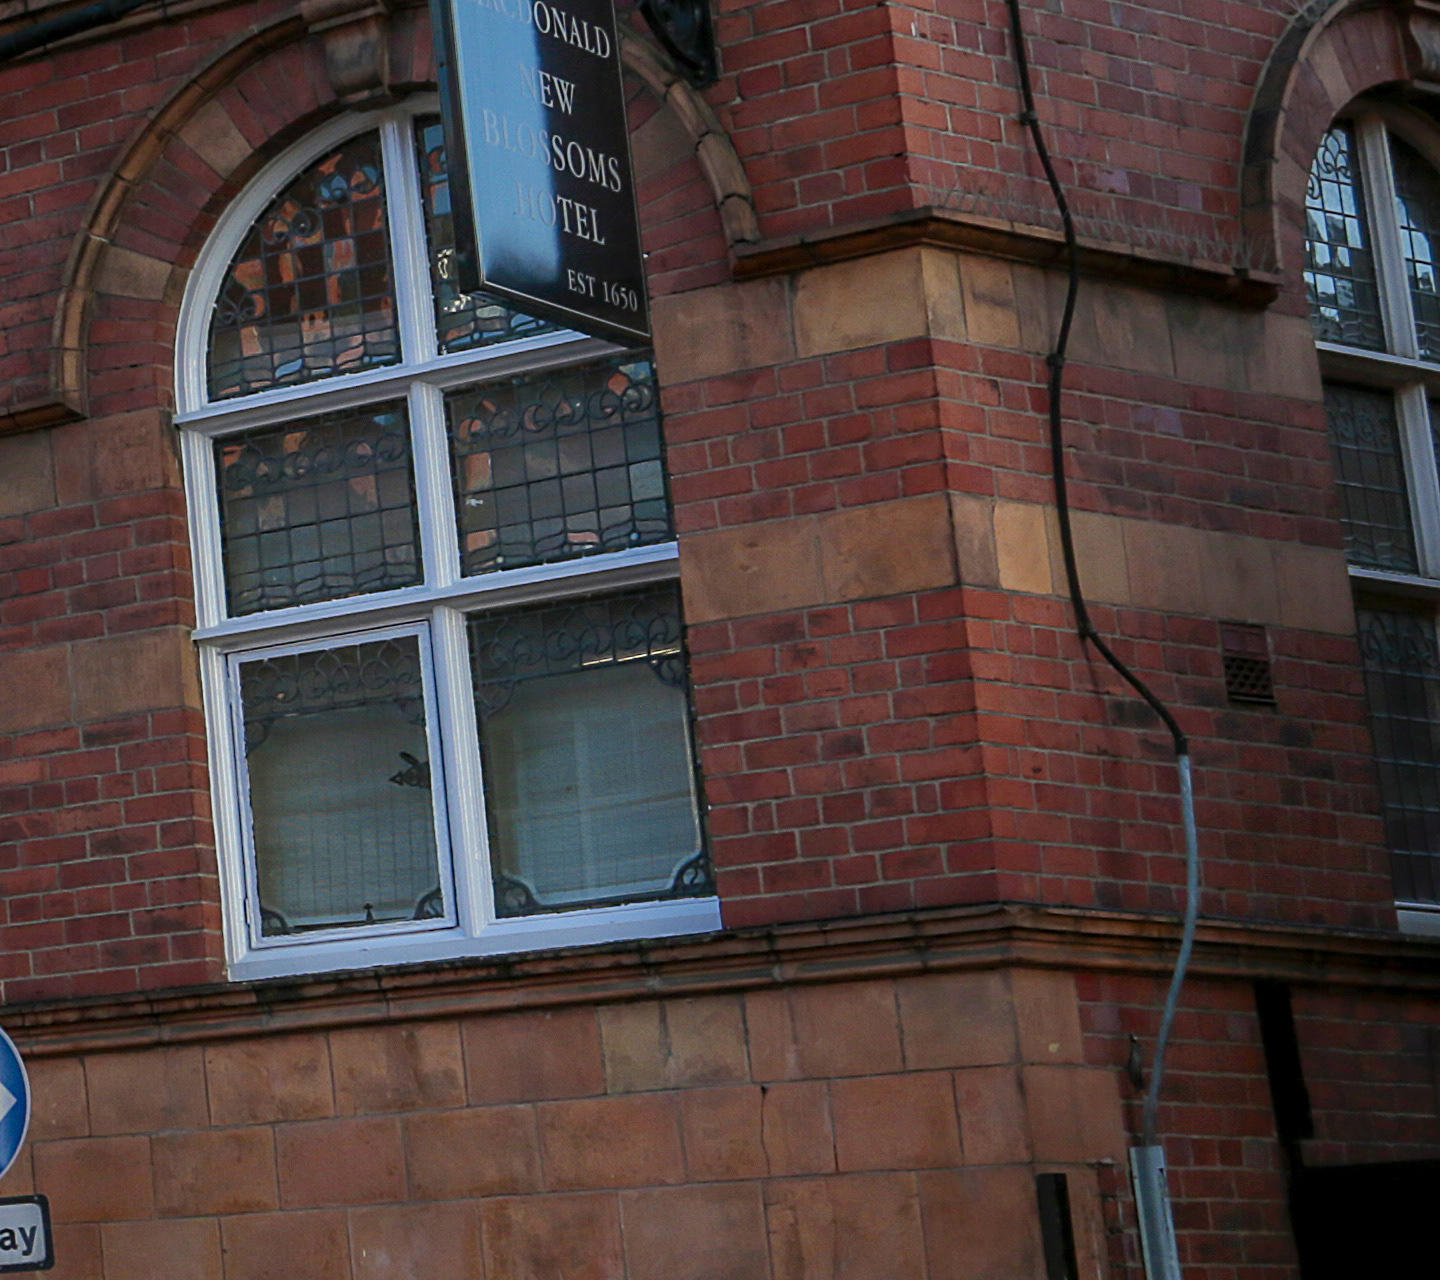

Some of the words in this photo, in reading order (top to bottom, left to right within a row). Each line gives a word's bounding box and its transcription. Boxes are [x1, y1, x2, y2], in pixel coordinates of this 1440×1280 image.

[519, 63, 575, 115] NEW
[481, 108, 621, 192] BLOSSOMS
[514, 181, 605, 245] HOTEL
[568, 269, 595, 297] EST
[602, 281, 638, 312] 1650
